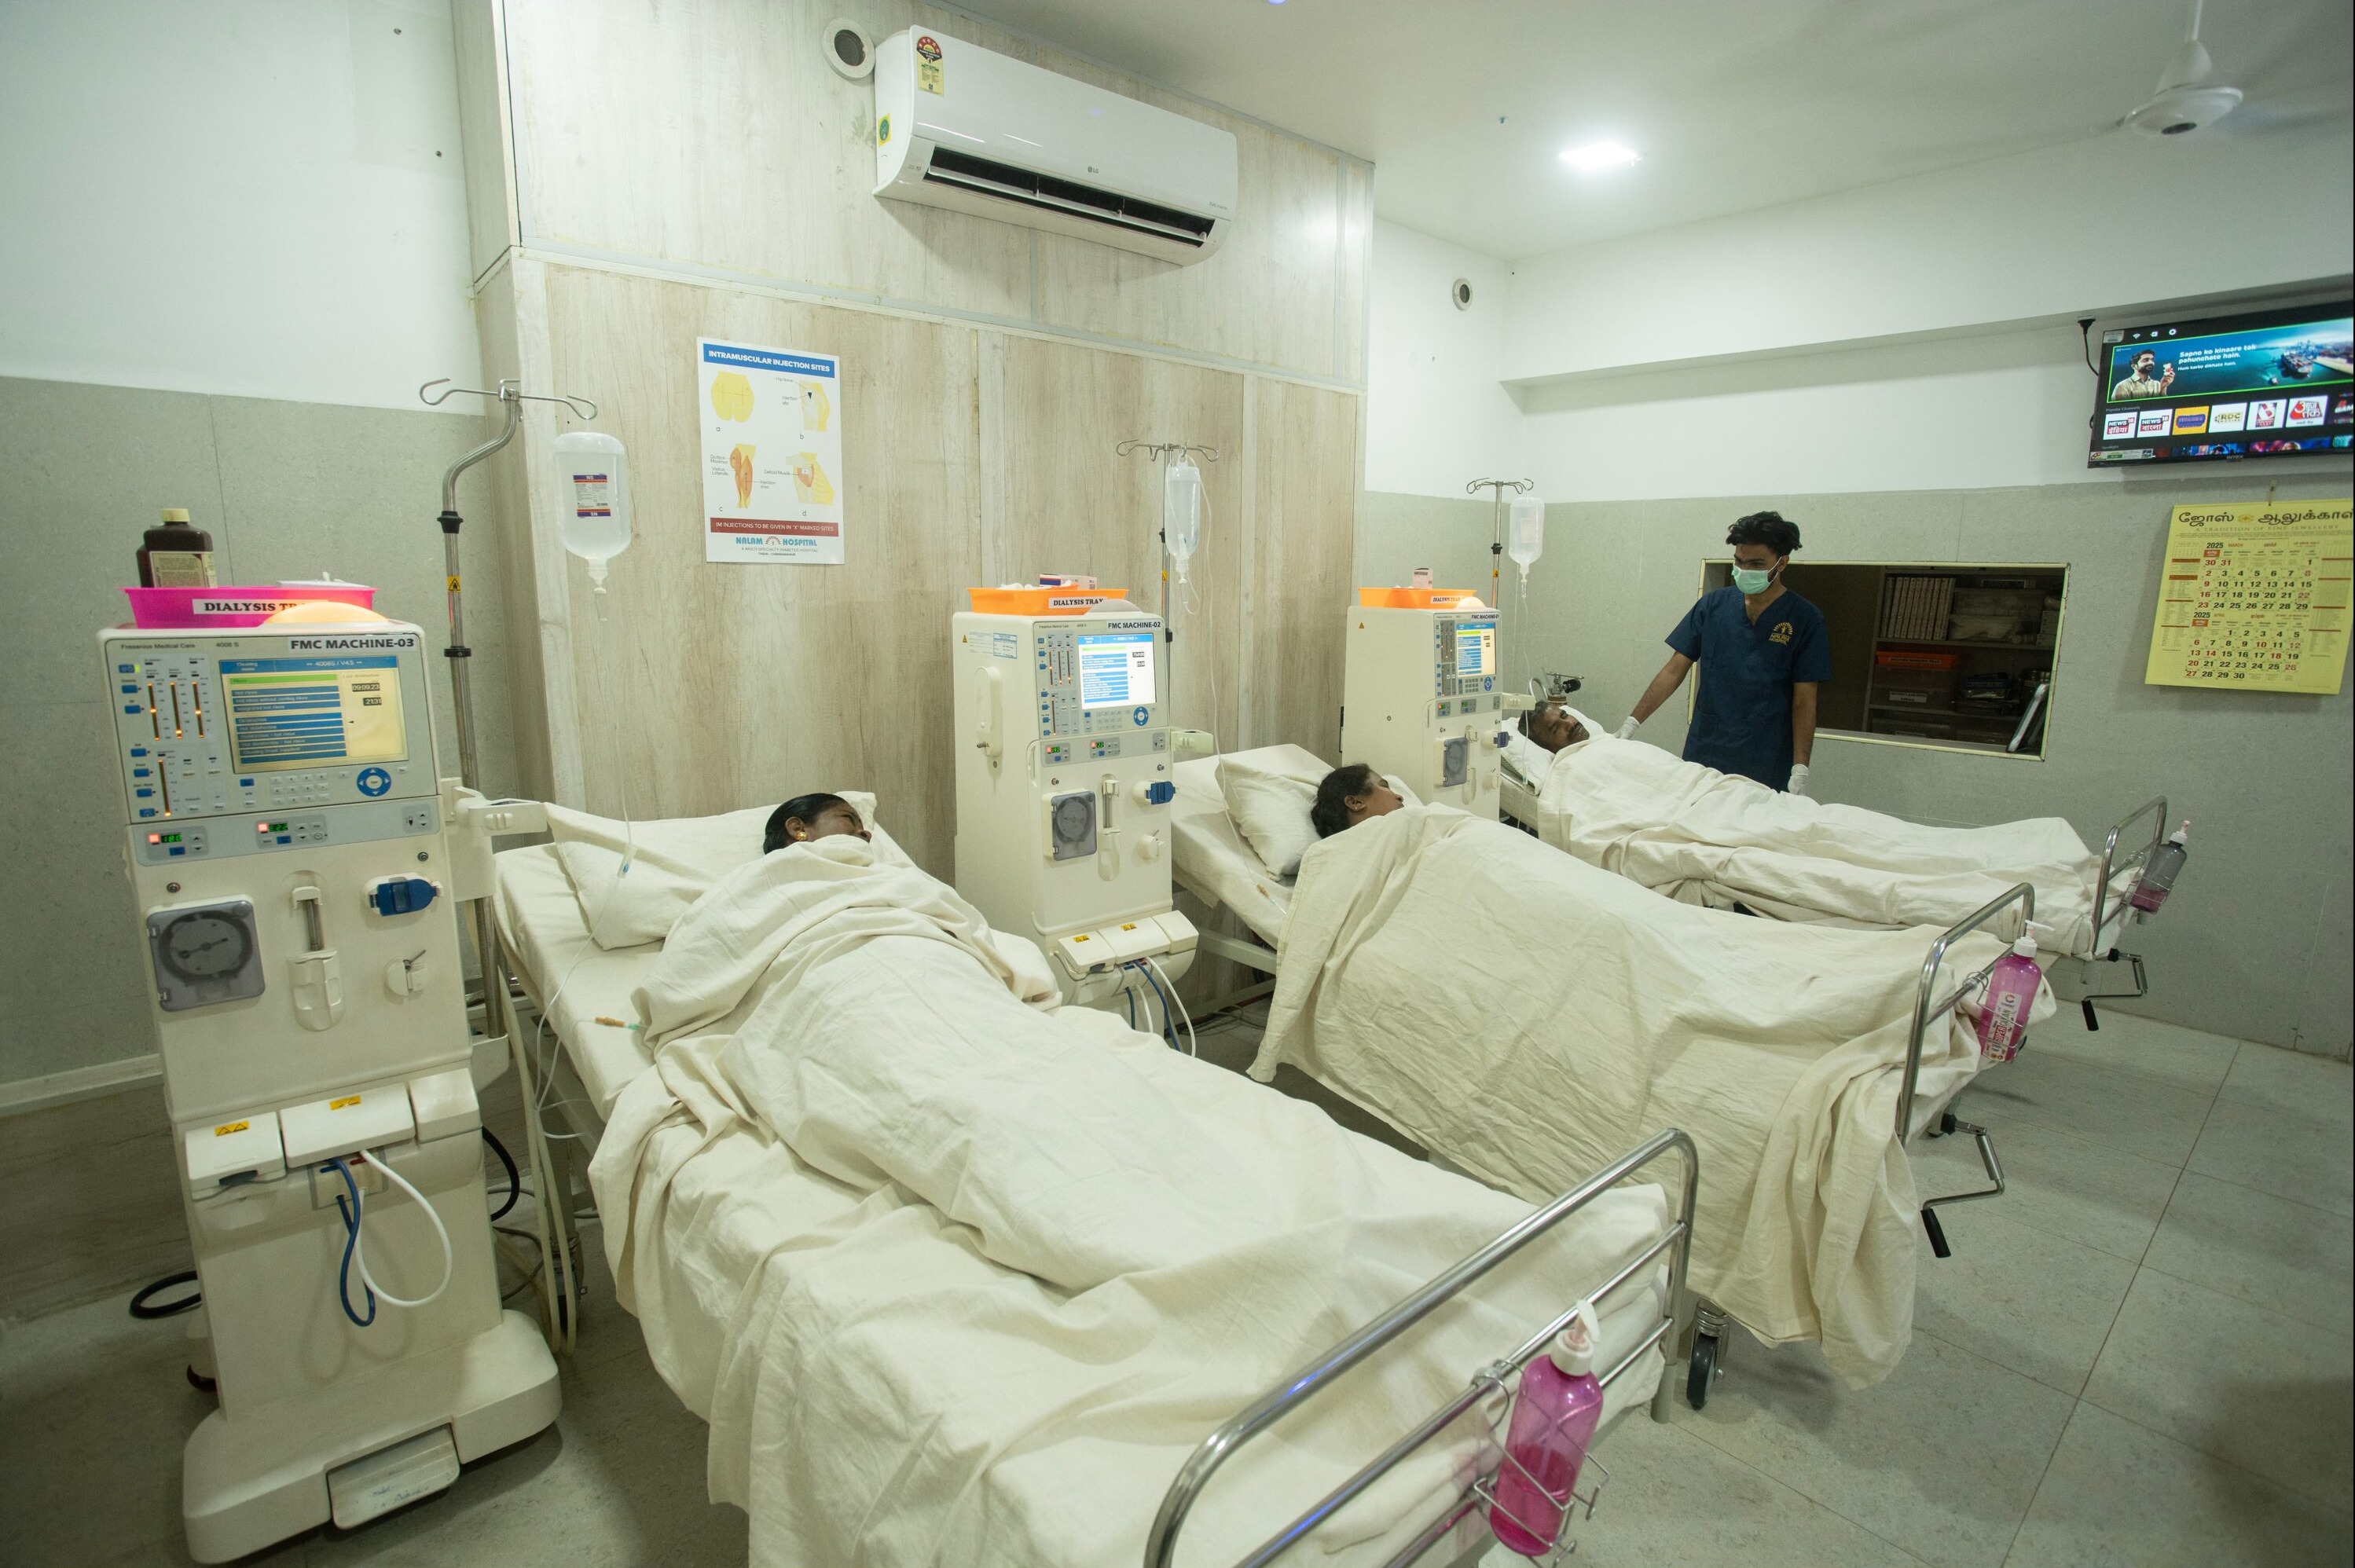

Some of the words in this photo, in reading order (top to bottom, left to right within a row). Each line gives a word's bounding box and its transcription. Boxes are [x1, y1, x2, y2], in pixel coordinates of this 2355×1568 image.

[709, 350, 772, 365] INTRAMUSCULAR
[772, 359, 810, 369] INJECTION
[811, 364, 831, 372] SITES
[2178, 354, 2221, 365] pahunchate
[2107, 426, 2128, 434] इंडिया
[2178, 511, 2234, 527] ஜோஸ்
[783, 538, 817, 547] HOSPITAL
[204, 603, 276, 611] DIALYSIS
[291, 640, 321, 649] FMC
[326, 638, 414, 649] MACHINE-03
[1993, 1024, 2007, 1044] SUPER
